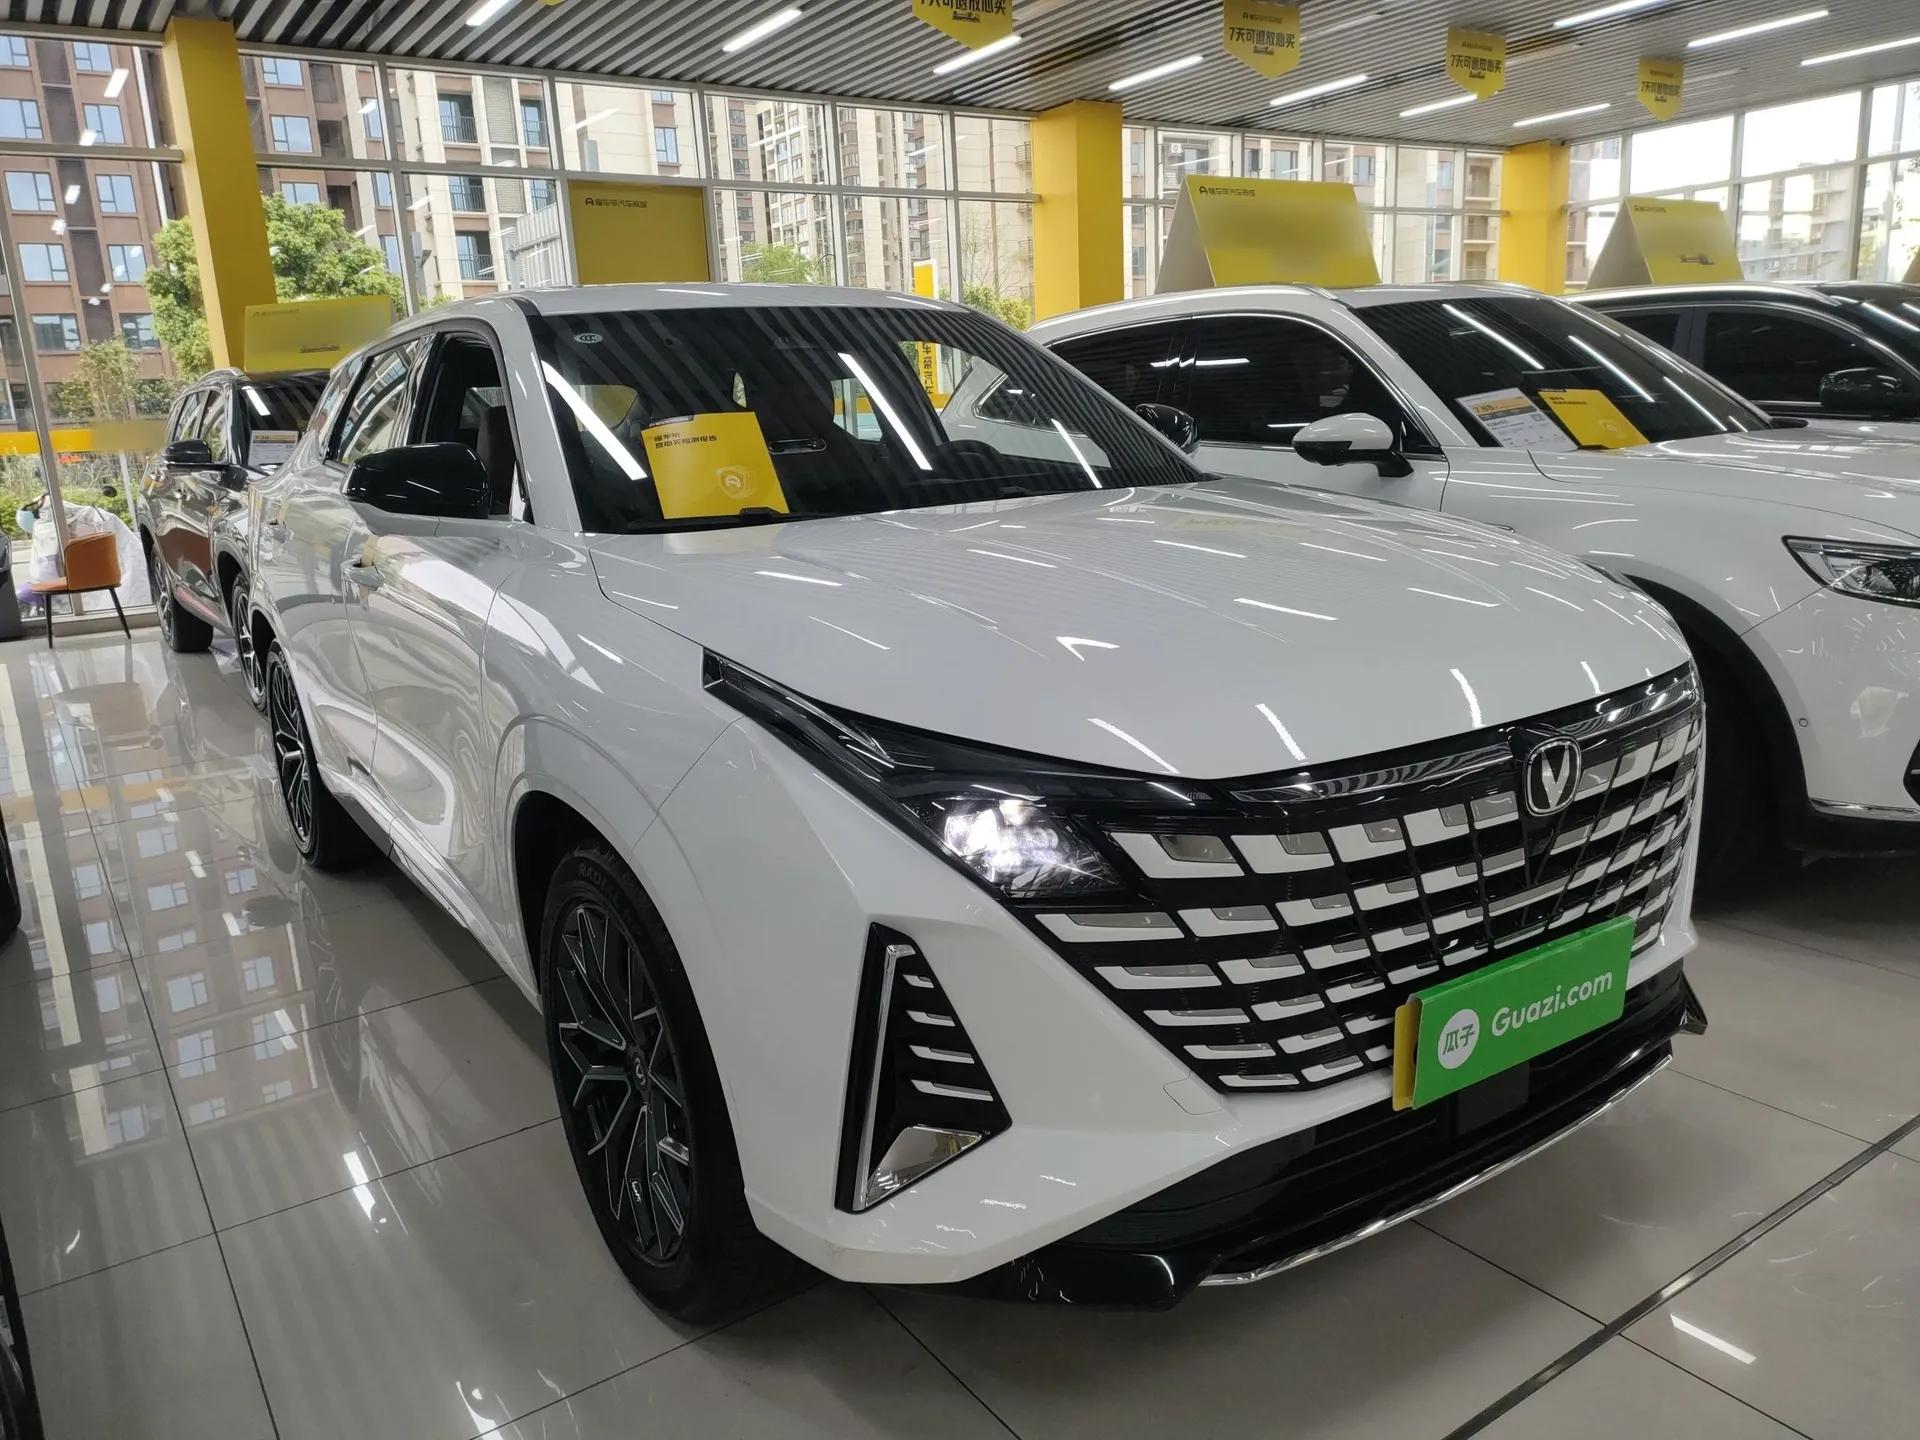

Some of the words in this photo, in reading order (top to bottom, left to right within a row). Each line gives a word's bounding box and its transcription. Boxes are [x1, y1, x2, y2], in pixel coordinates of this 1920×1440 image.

[920, 0, 1007, 15] 可退放心买
[1229, 27, 1296, 48] 7天可退放心买
[1491, 971, 1613, 1037] Guazi.com
[1442, 1023, 1476, 1056] 瓜子
